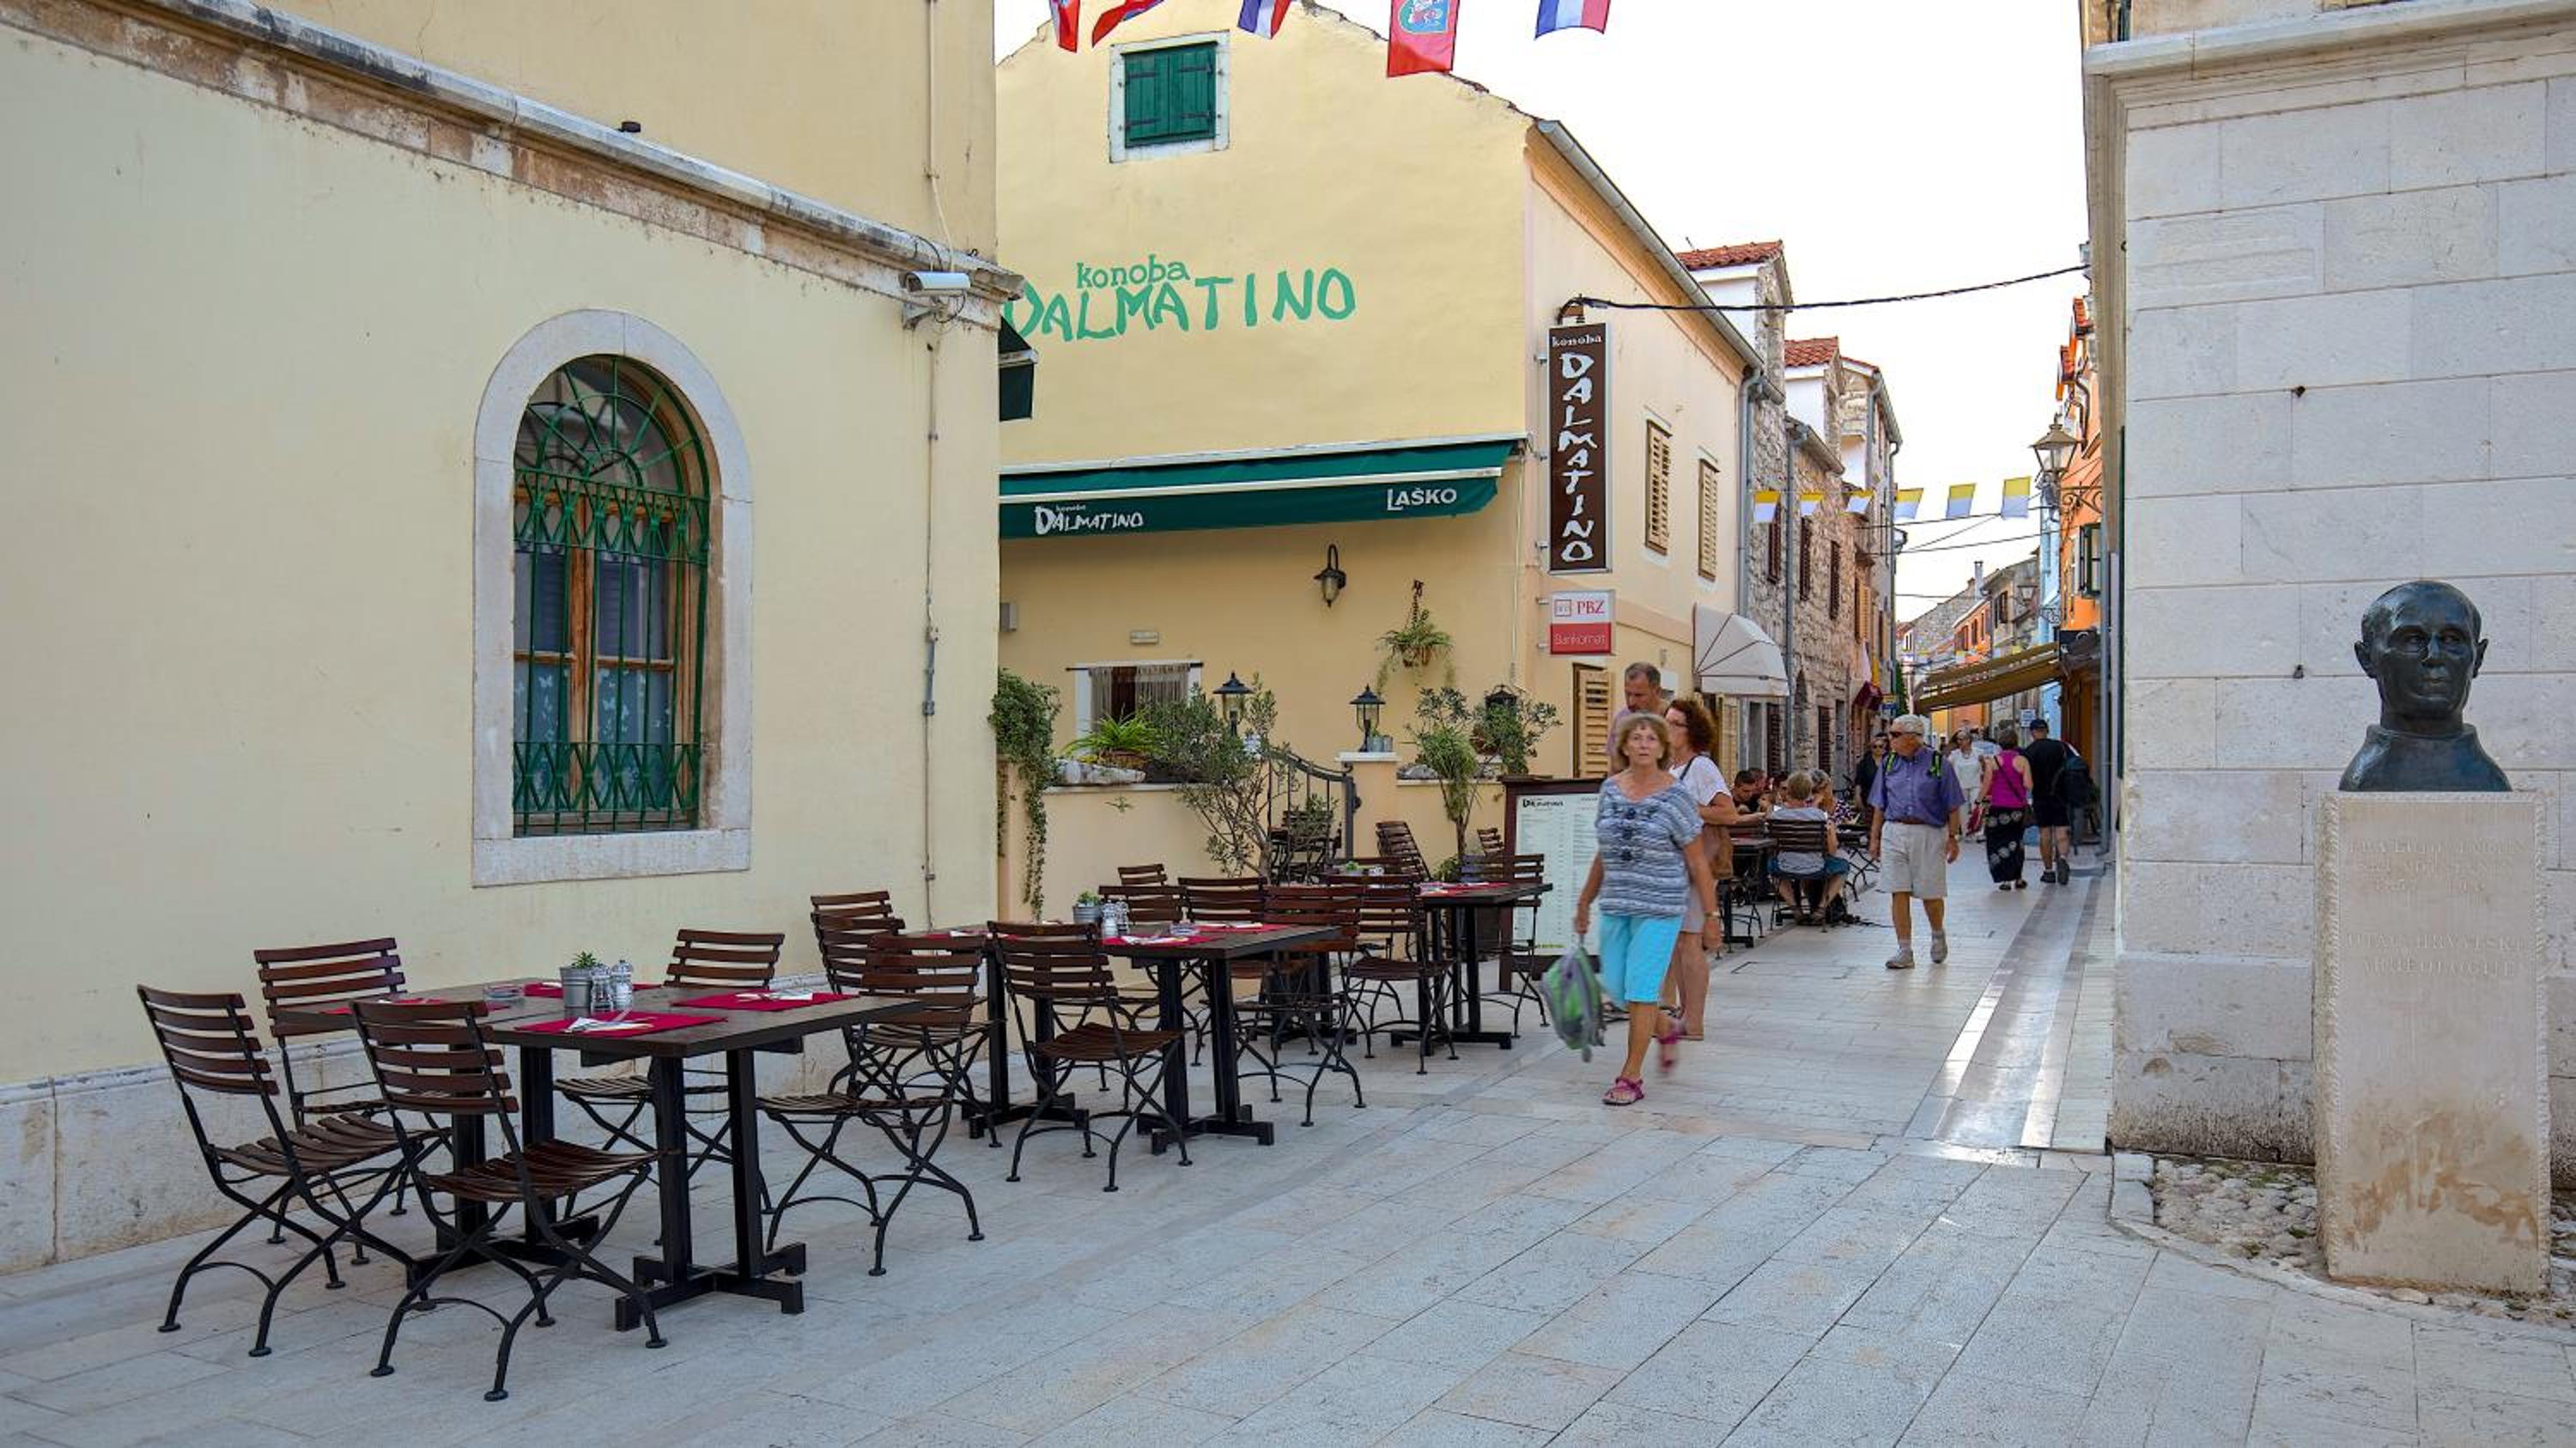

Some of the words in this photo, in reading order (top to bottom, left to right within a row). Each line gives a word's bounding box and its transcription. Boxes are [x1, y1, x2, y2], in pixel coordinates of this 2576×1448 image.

[1076, 254, 1191, 289] konoba
[1003, 267, 1357, 342] DALMATINO
[1551, 333, 1603, 348] konoba
[1557, 352, 1598, 563] DALMATINO
[1386, 487, 1458, 512] LAŠKO
[1034, 505, 1145, 535] DALMATINO
[1577, 599, 1606, 615] PBZ
